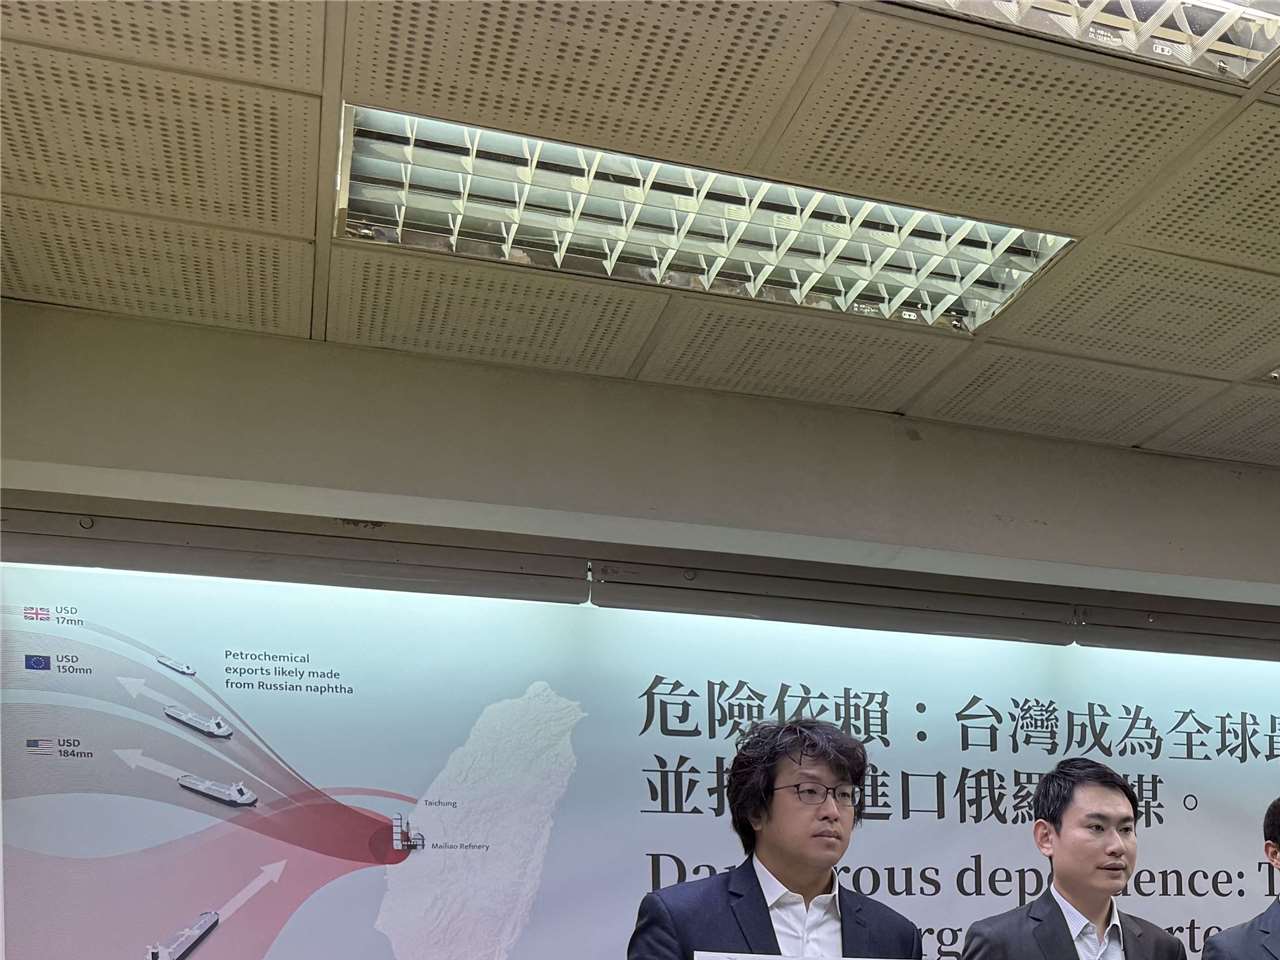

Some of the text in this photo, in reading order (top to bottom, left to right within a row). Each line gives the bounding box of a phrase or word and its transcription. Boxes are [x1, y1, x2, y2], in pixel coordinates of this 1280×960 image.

[55, 605, 78, 616] USD
[55, 616, 84, 626] 17mn
[56, 654, 79, 665] USD
[225, 650, 310, 664] Petrochemical
[56, 665, 93, 675] 150mn
[225, 666, 341, 680] exports likely made
[225, 679, 354, 696] from Russian naphtha
[58, 738, 81, 749] USD
[58, 749, 94, 760] 184mn
[424, 799, 457, 808] Taichung
[459, 843, 490, 851] Refinery
[956, 854, 1246, 907] depence:
